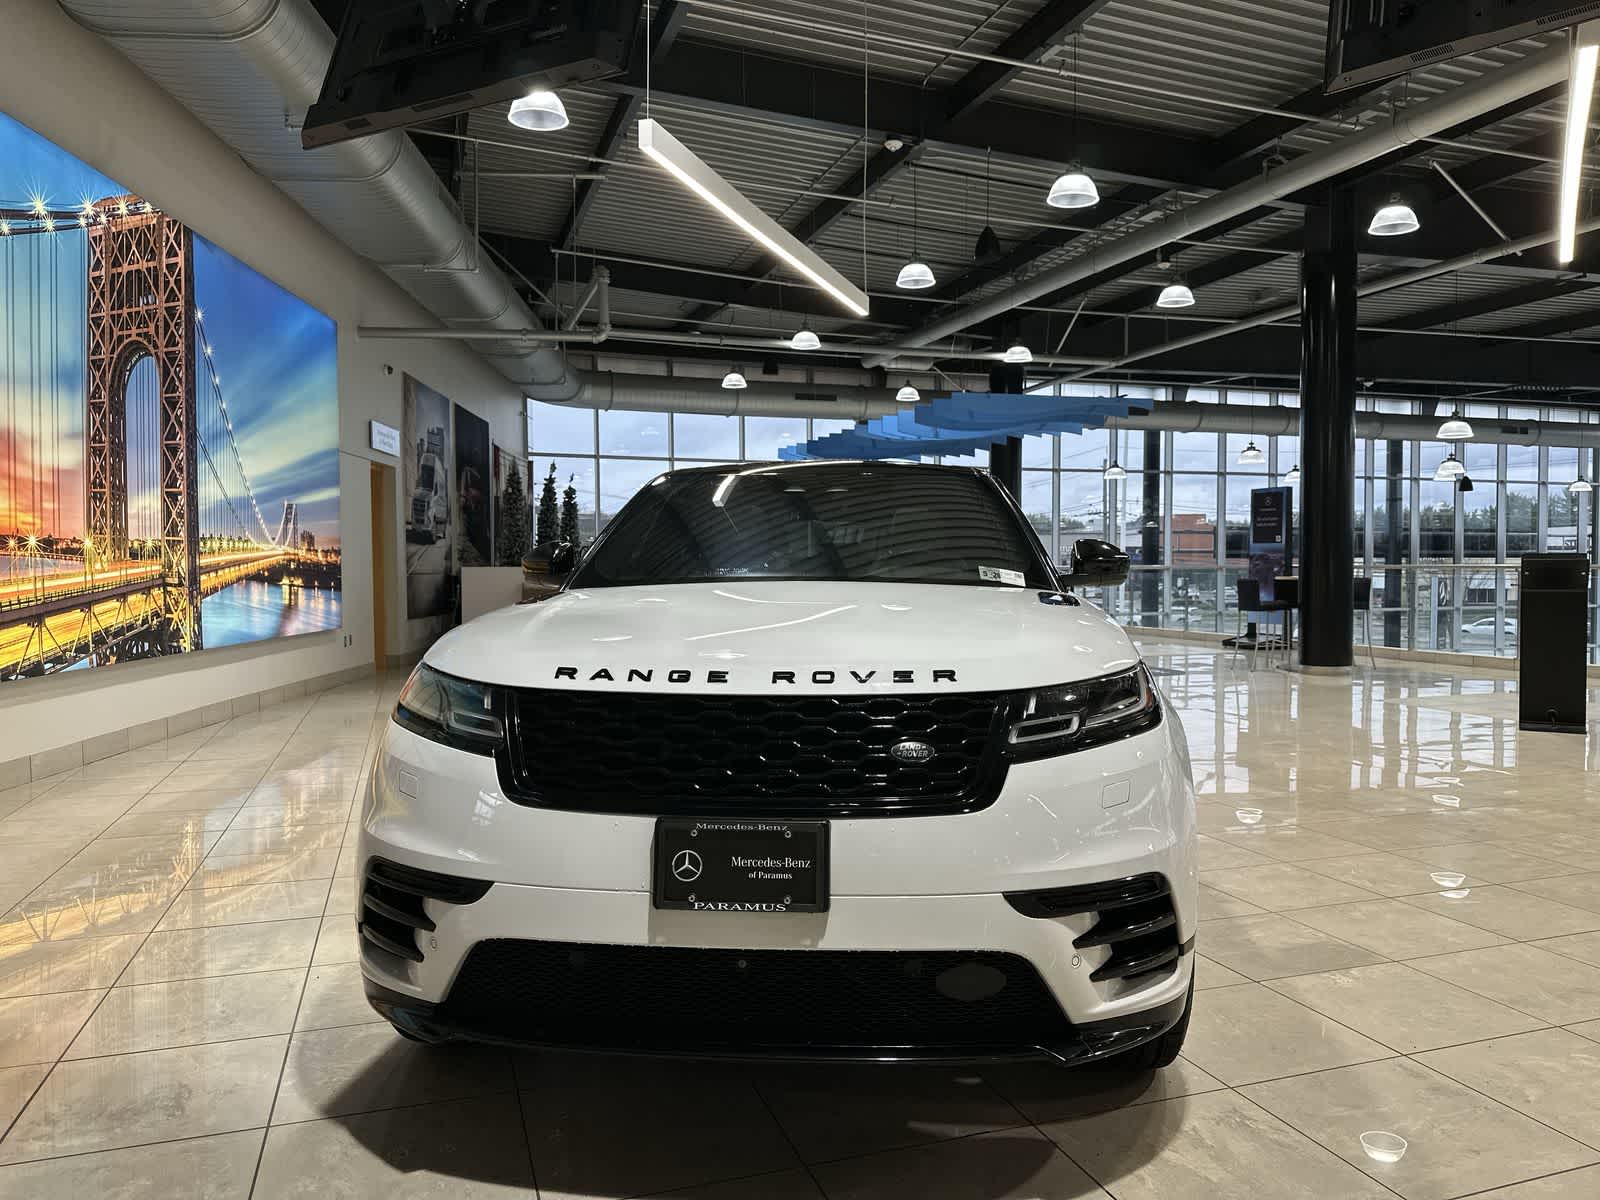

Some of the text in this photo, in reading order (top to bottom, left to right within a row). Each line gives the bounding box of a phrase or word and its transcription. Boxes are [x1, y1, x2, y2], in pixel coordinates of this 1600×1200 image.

[554, 666, 958, 684] RANGE ROVER
[902, 750, 928, 758] ROVER
[696, 823, 788, 832] Mercedes-Benz
[731, 856, 811, 869] Mercedes-Benz
[748, 871, 793, 880] of Paramus
[694, 902, 787, 912] PARAMUS
